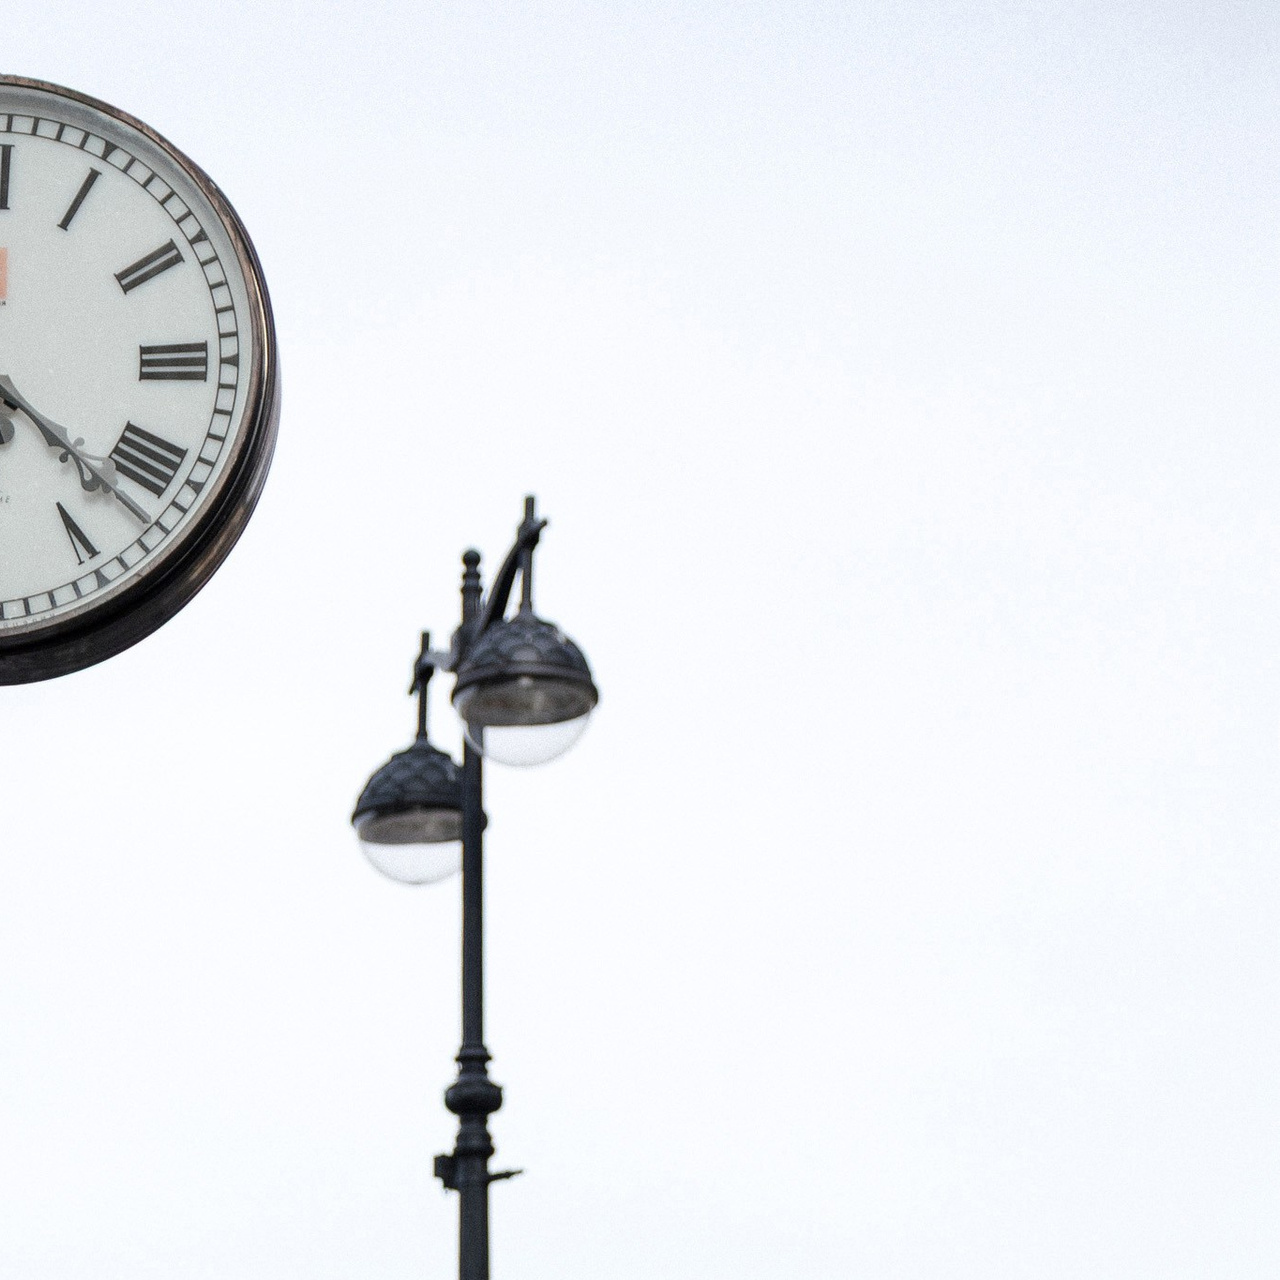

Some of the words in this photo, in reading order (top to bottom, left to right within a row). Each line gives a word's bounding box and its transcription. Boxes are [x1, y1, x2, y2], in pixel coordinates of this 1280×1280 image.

[114, 238, 186, 295] II
[139, 341, 208, 382] III
[56, 501, 102, 565] V
